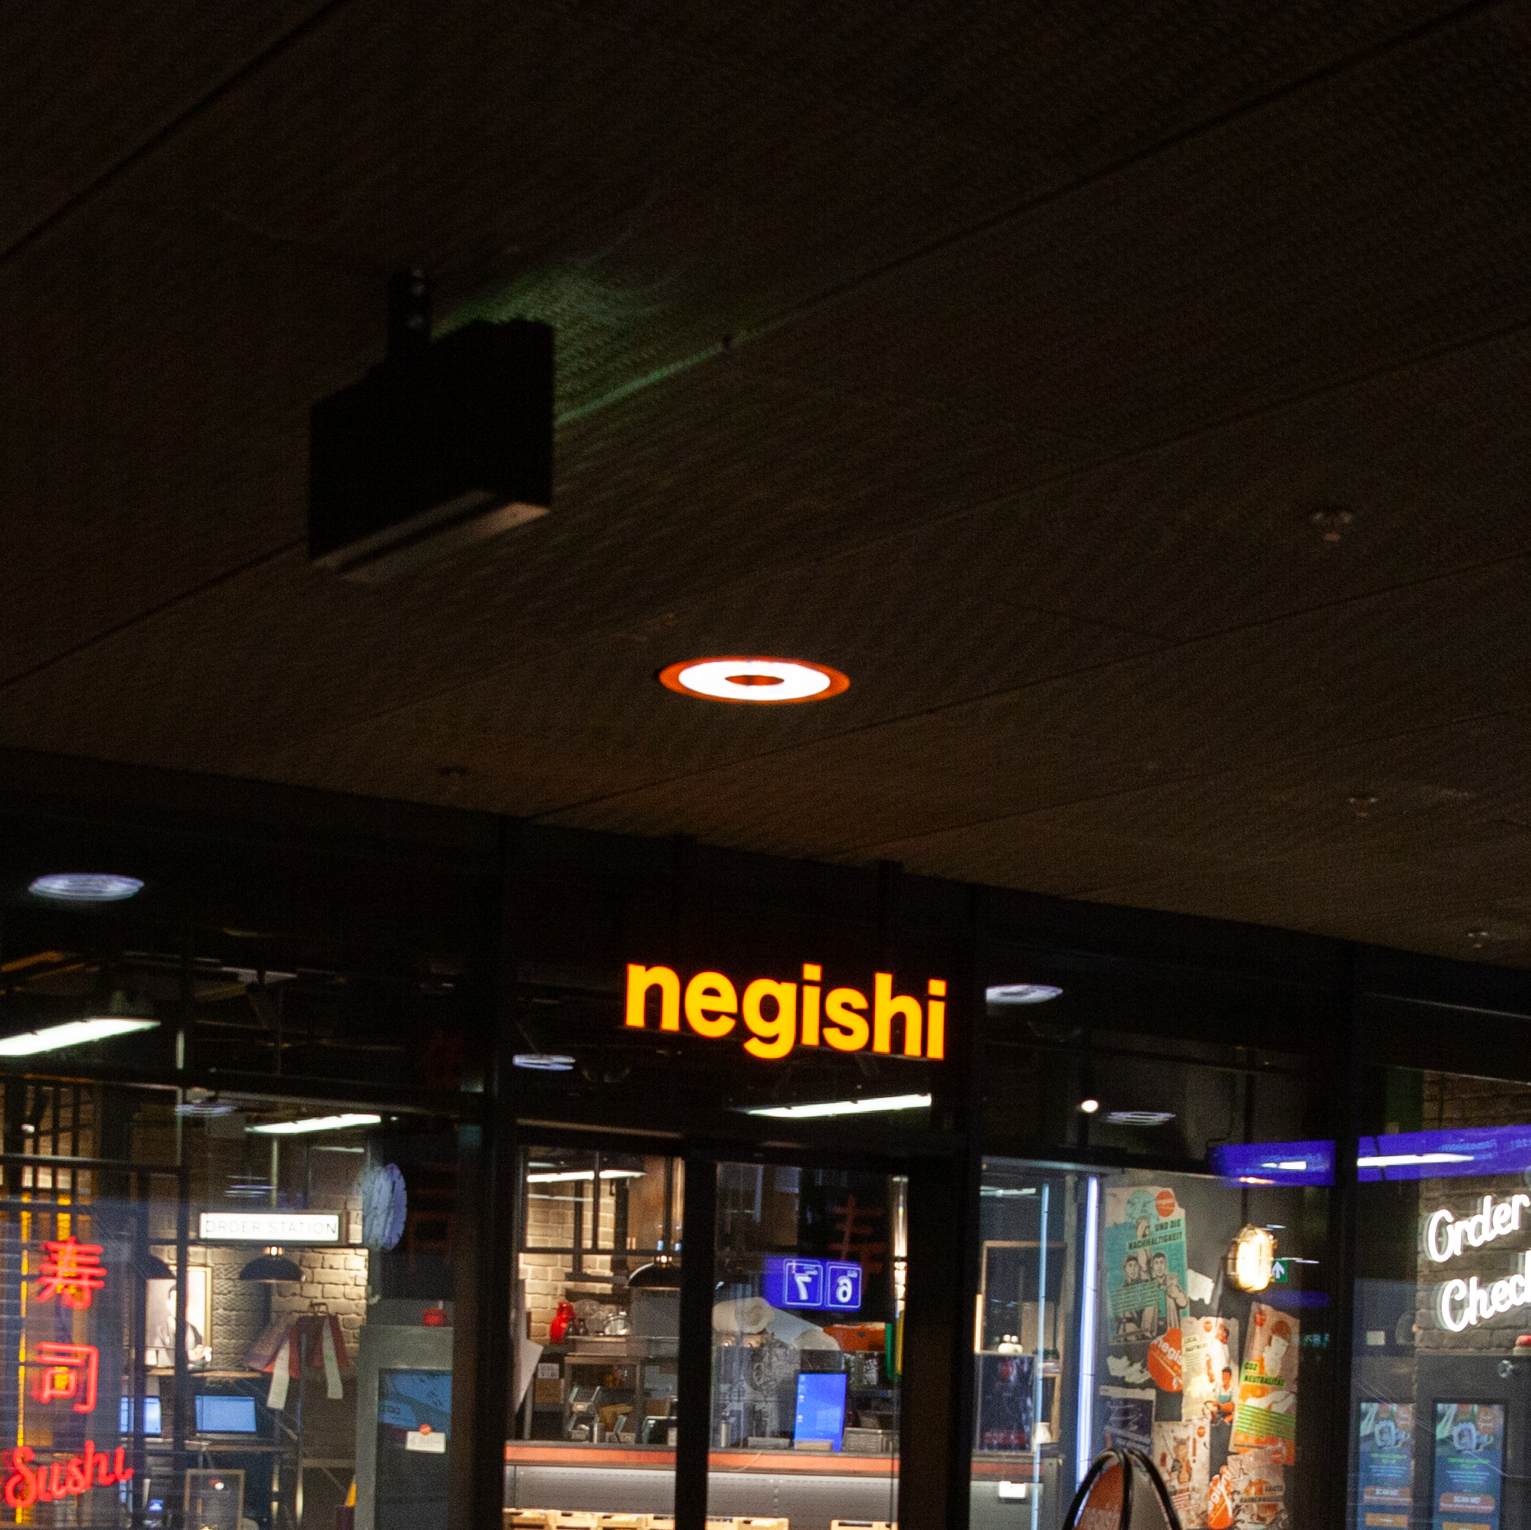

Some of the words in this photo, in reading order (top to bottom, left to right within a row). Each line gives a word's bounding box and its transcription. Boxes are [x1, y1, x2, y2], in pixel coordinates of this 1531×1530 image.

[624, 962, 948, 1060] negishi
[206, 1219, 260, 1233] ORDER
[268, 1220, 337, 1235] STATION
[1170, 1218, 1181, 1229] DIE
[1426, 1192, 1530, 1263] Order
[36, 1236, 107, 1413] 寿司
[1244, 1362, 1258, 1371] CO2
[3, 1440, 135, 1509] Sushi
